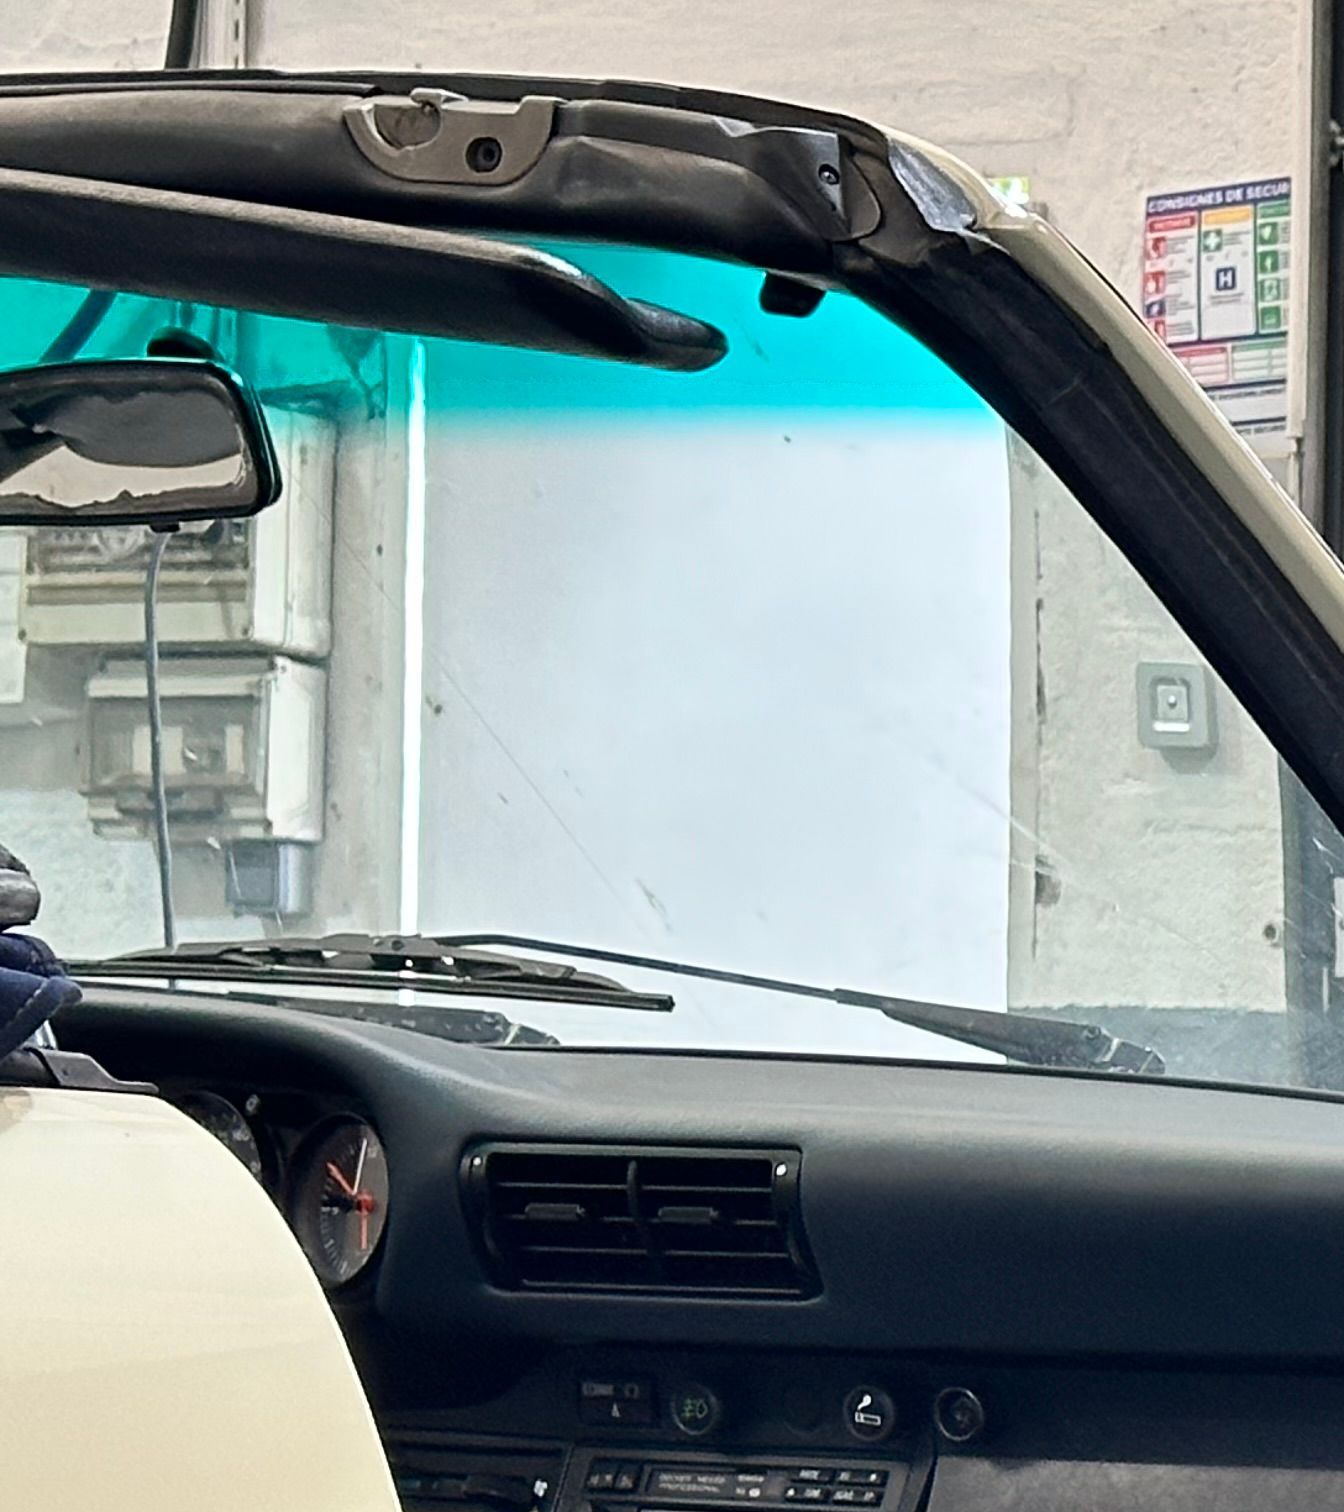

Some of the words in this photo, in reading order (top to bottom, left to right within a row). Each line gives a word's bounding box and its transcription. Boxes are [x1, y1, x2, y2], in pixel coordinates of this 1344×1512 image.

[1148, 189, 1223, 213] CONSIGNES
[1225, 187, 1243, 203] DE
[1218, 269, 1233, 288] H
